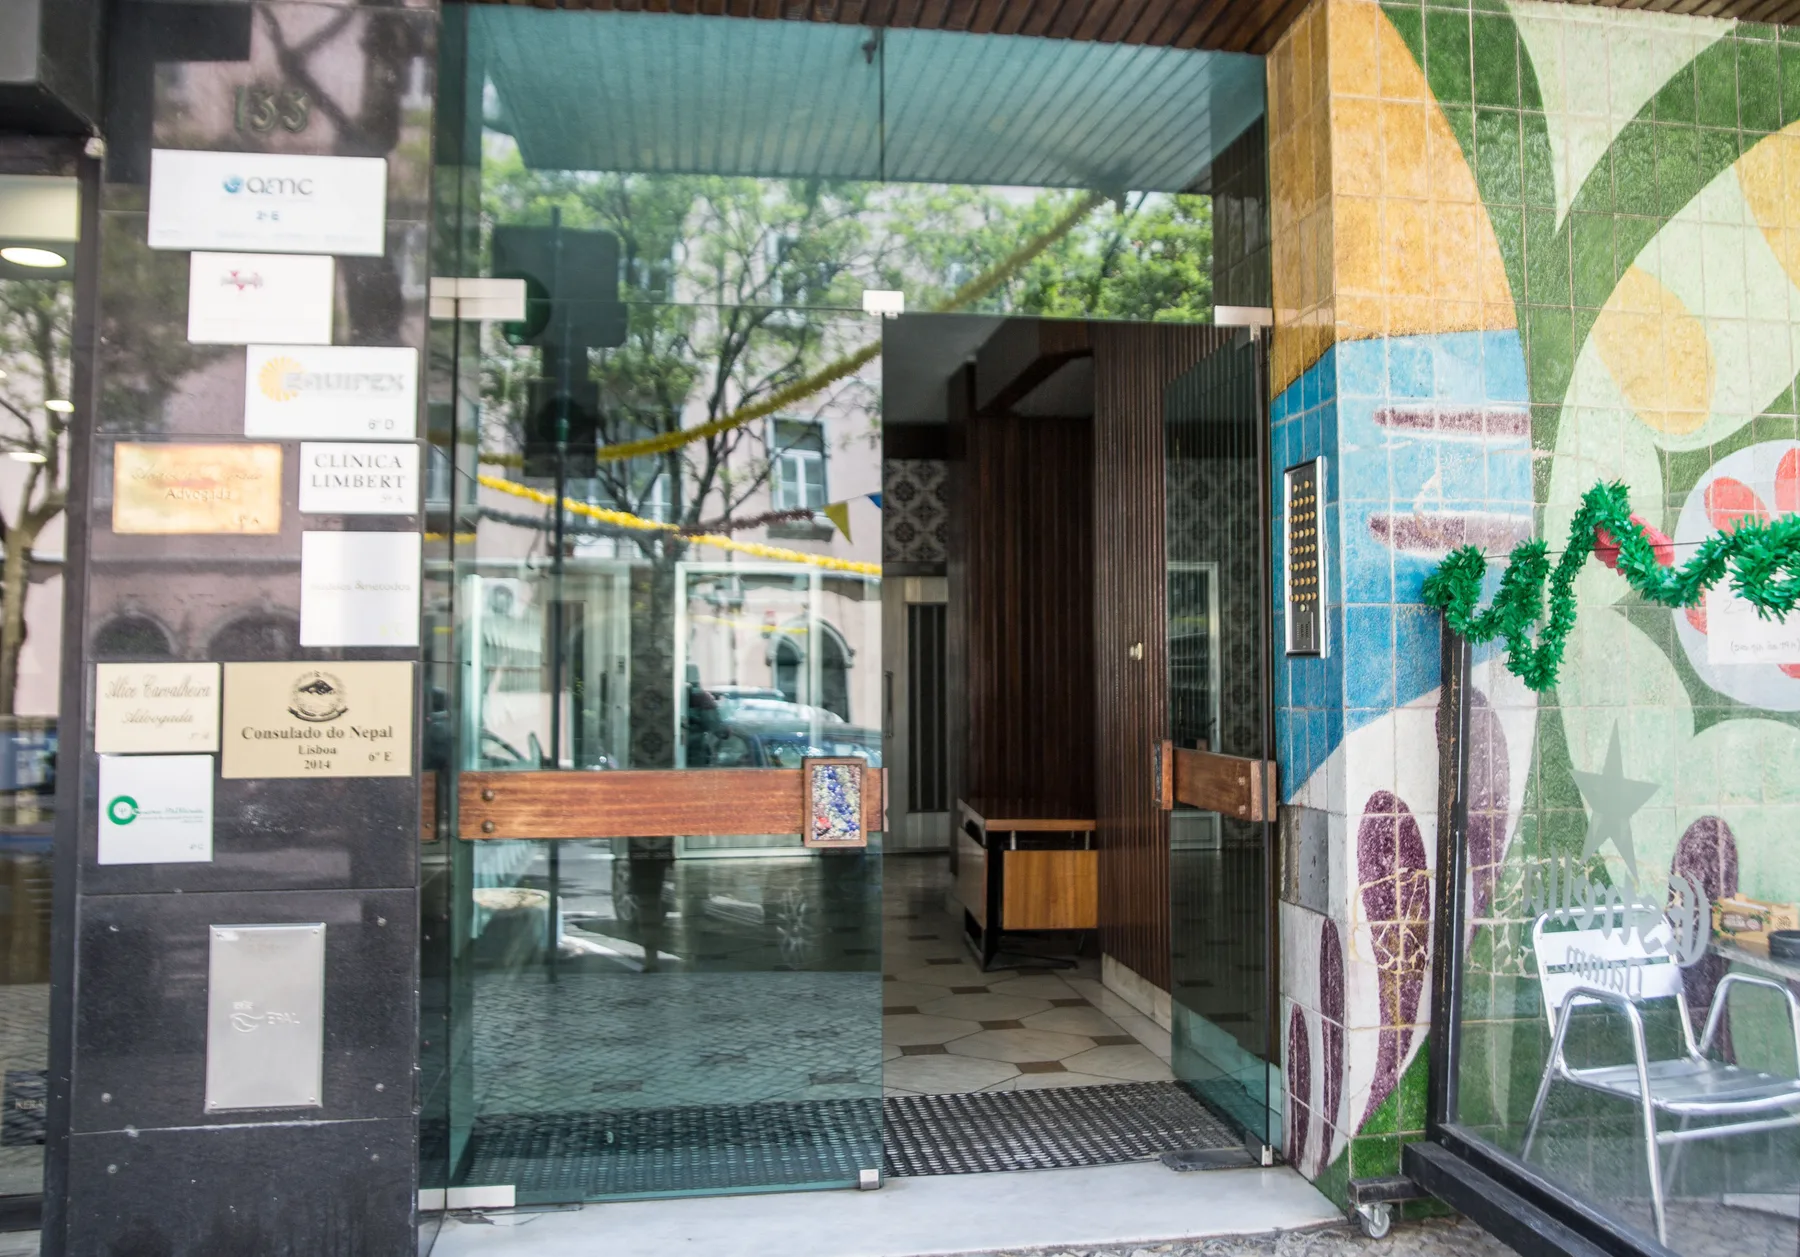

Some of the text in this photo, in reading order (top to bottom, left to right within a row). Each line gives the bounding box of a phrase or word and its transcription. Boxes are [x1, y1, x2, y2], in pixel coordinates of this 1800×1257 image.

[235, 85, 310, 132] 133
[384, 418, 395, 430] D
[312, 474, 406, 489] LIMBERT
[104, 674, 137, 699] Alice
[241, 725, 393, 742] Consulado do Nepal
[297, 744, 337, 756] Lisboa
[384, 751, 394, 762] E
[303, 759, 331, 770] 2014
